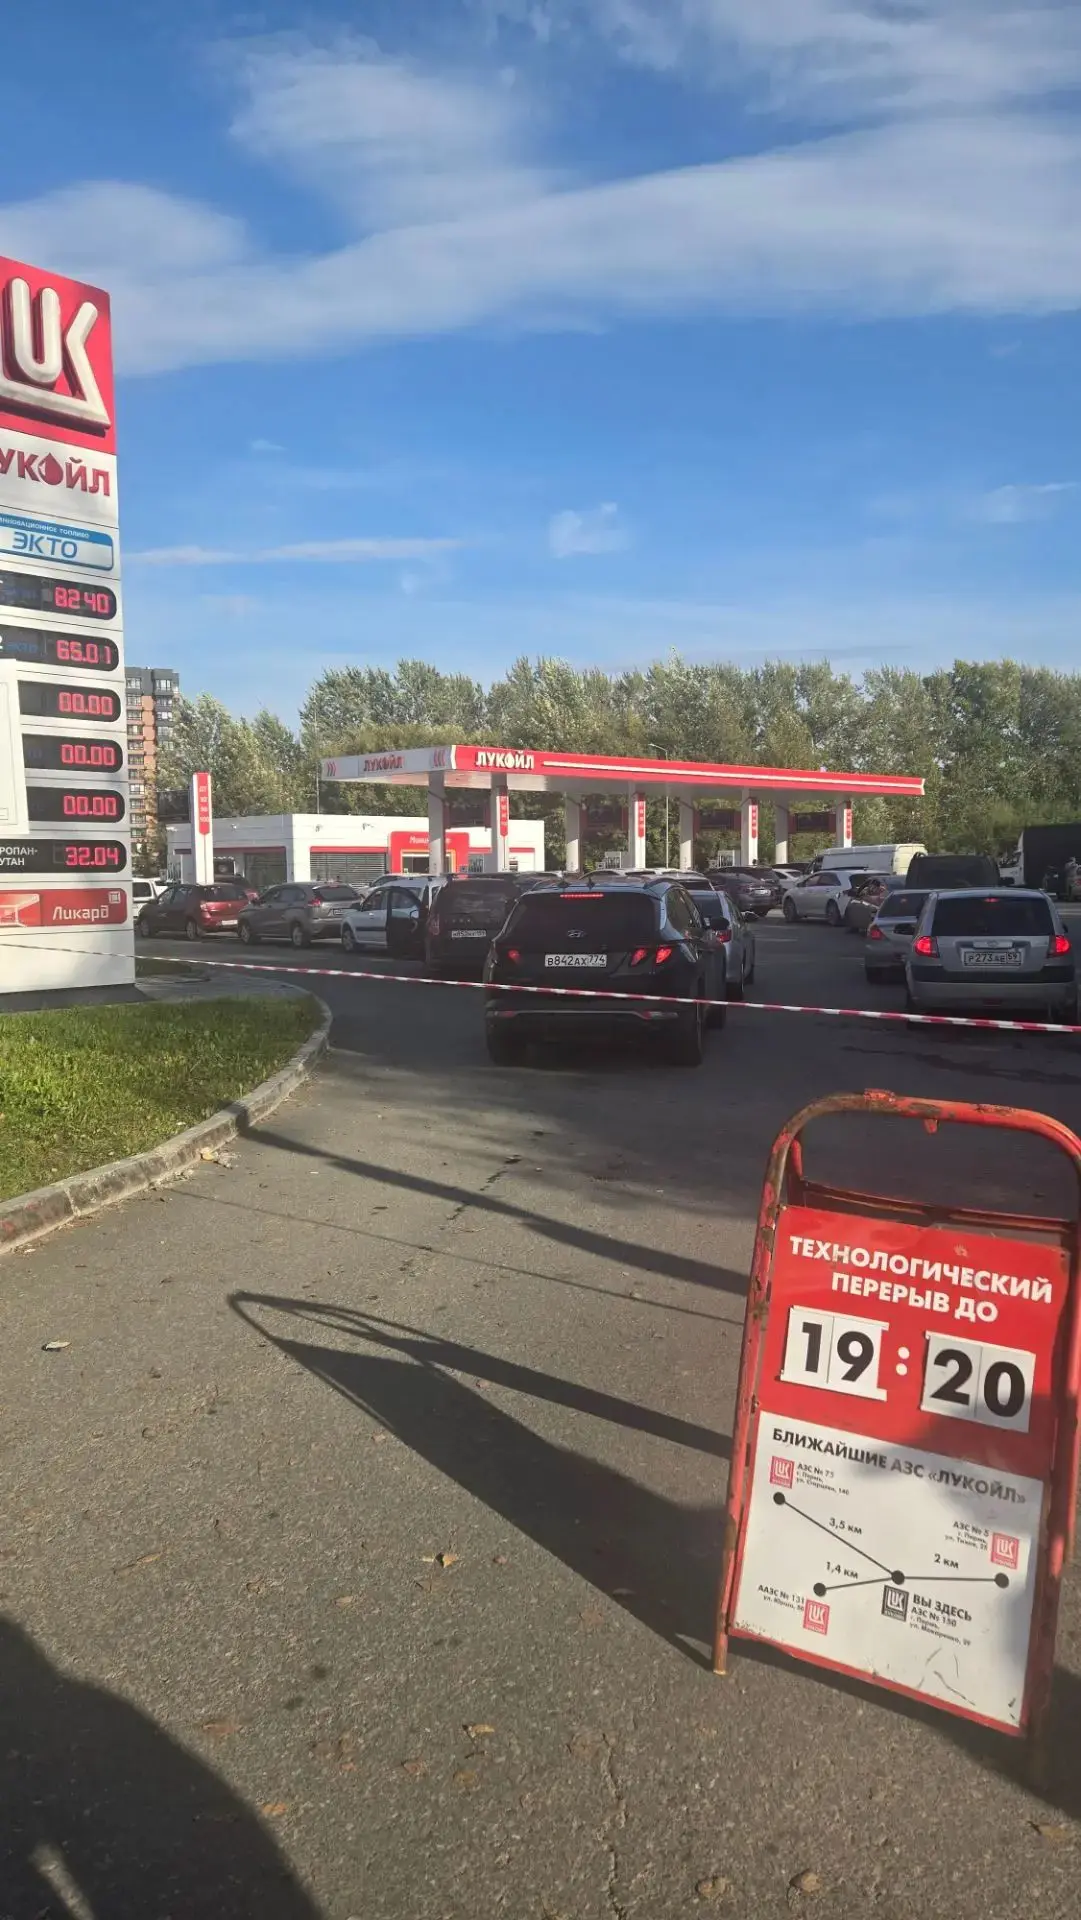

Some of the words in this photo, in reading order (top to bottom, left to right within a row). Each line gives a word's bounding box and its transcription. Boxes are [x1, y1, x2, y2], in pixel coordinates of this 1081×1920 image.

[60, 528, 90, 539] ТОПЛИВО
[12, 531, 78, 559] ЭКТО
[57, 639, 112, 664] 65.01
[58, 692, 113, 715] 00.00
[61, 744, 115, 766] 00.00
[475, 751, 535, 770] ЛУКОЙЛ
[63, 796, 117, 816] 00.00
[65, 847, 119, 866] 32.04
[53, 905, 109, 921] Ликард
[790, 1236, 1053, 1303] ТЕХНОЛОГИЧЕСКИЙ
[832, 1272, 950, 1313] ПЕРЕРЫВ
[954, 1297, 998, 1323] ДО
[773, 1428, 888, 1468] БЛИЖАЙШИЕ
[891, 1459, 925, 1478] АЗС
[928, 1470, 1026, 1504] «ЛУКОЙЛ»
[797, 1463, 812, 1473] АЗС
[829, 1517, 846, 1529] 3,5
[848, 1525, 862, 1534] км
[952, 1521, 970, 1532] АЗС
[934, 1553, 941, 1563] 2
[943, 1558, 959, 1568] км
[826, 1562, 841, 1573] 1,4
[843, 1569, 858, 1579] км
[758, 1585, 779, 1595] ААЗС
[911, 1607, 928, 1617] АЗС
[929, 1612, 939, 1621] №
[913, 1594, 931, 1608] ВЫ
[934, 1601, 972, 1621] ЗДЕСЬ
